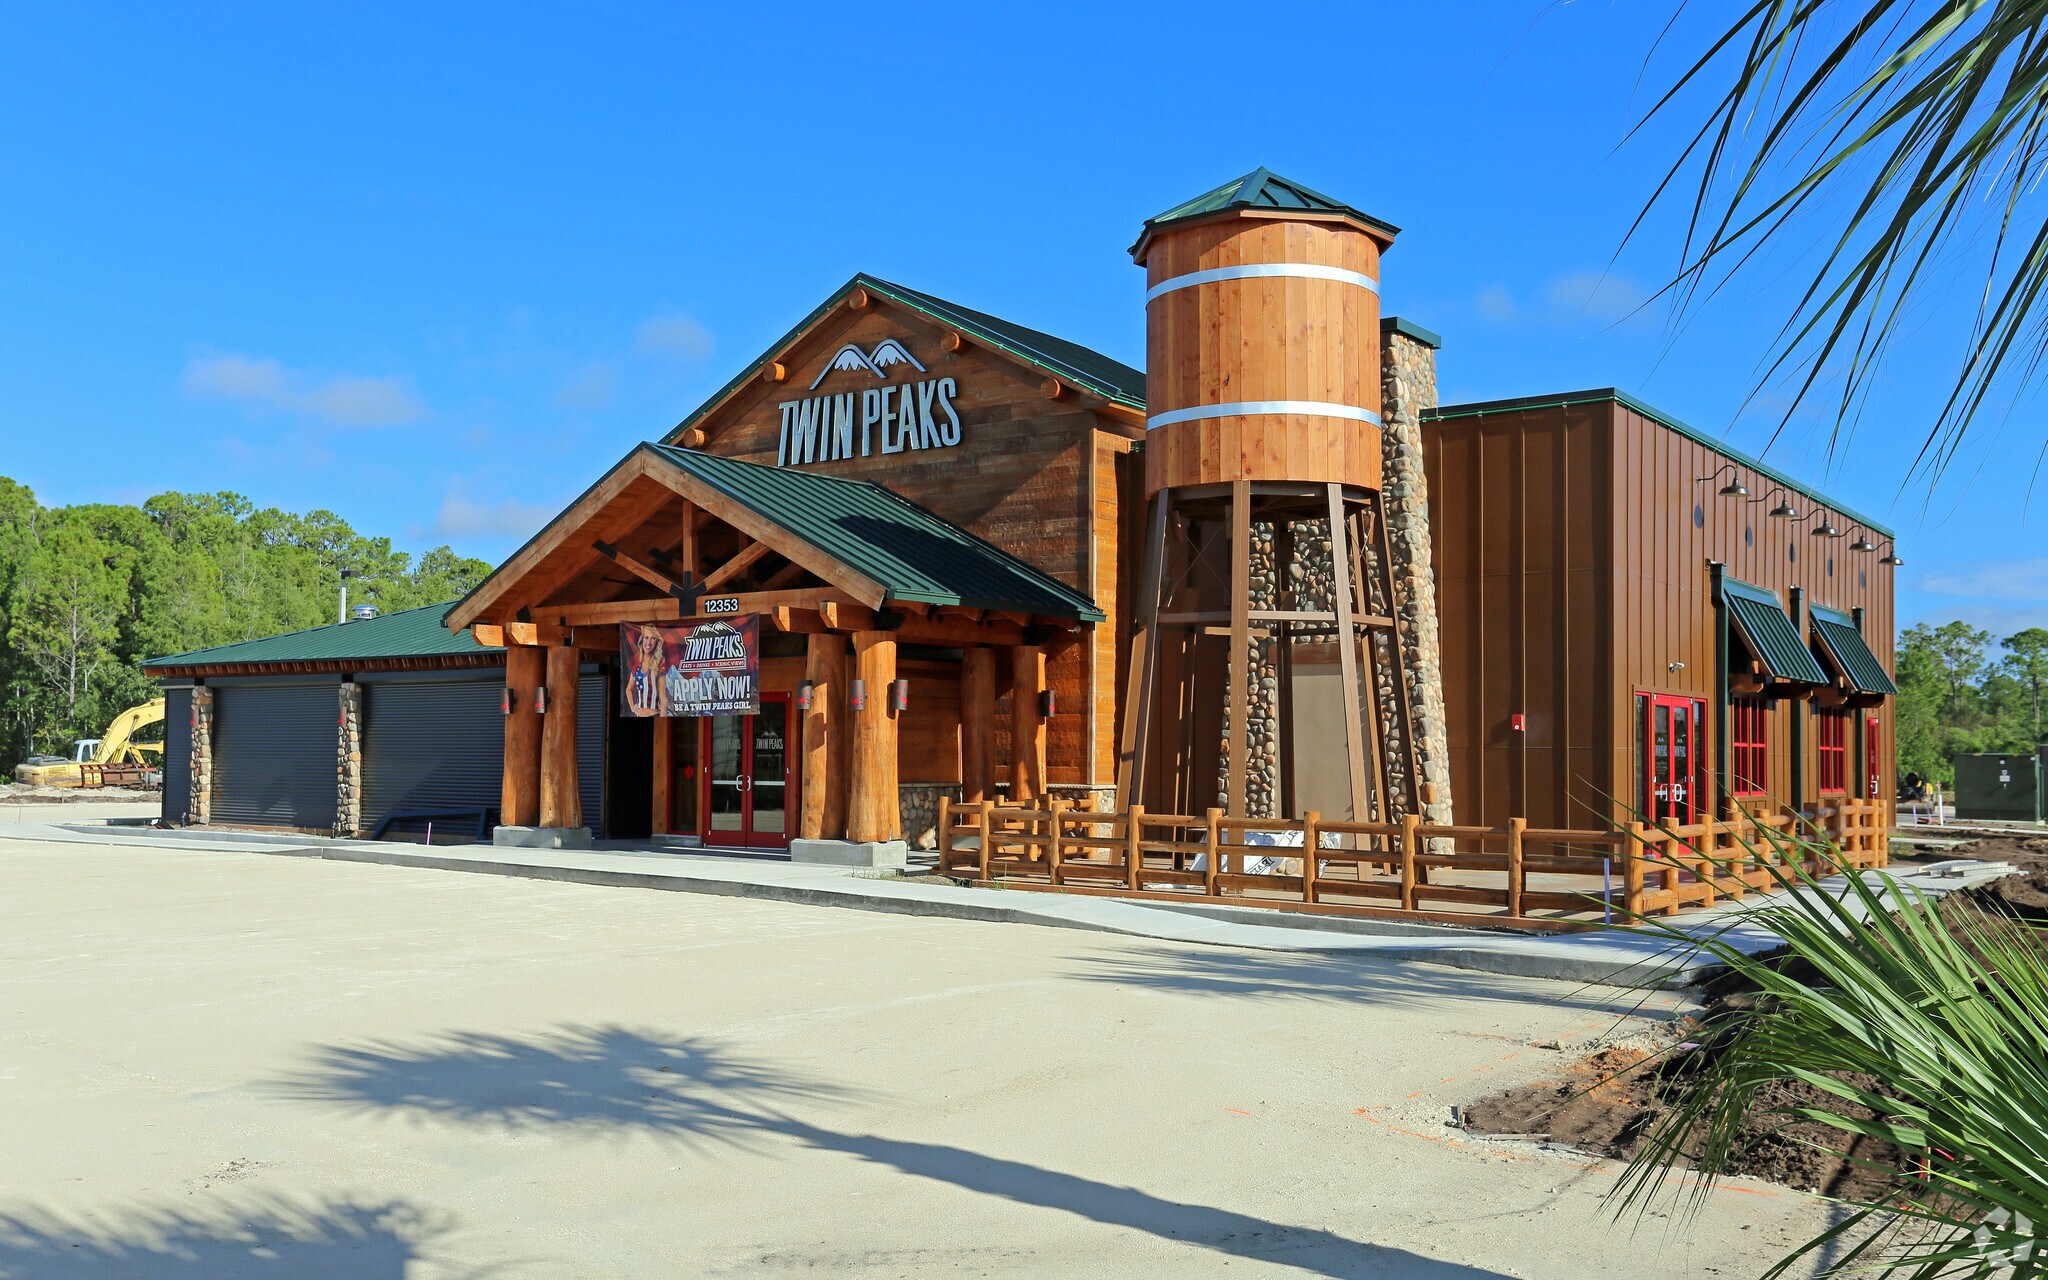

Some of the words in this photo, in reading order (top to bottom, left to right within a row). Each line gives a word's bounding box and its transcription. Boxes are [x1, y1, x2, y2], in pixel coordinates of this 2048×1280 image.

[778, 392, 854, 467] TWIN
[861, 377, 962, 457] PEAKS
[705, 599, 739, 613] 12353
[686, 637, 713, 661] TWIN
[712, 635, 744, 659] PEAKS
[673, 677, 714, 702] APPLY
[717, 675, 751, 700] NOW!
[674, 703, 683, 712] BE
[684, 703, 690, 711] A
[690, 702, 711, 711] TWIN
[712, 701, 733, 711] PEAKS
[734, 701, 751, 710] GIRL
[756, 738, 769, 750] TWIN
[769, 738, 784, 750] PEAKS
